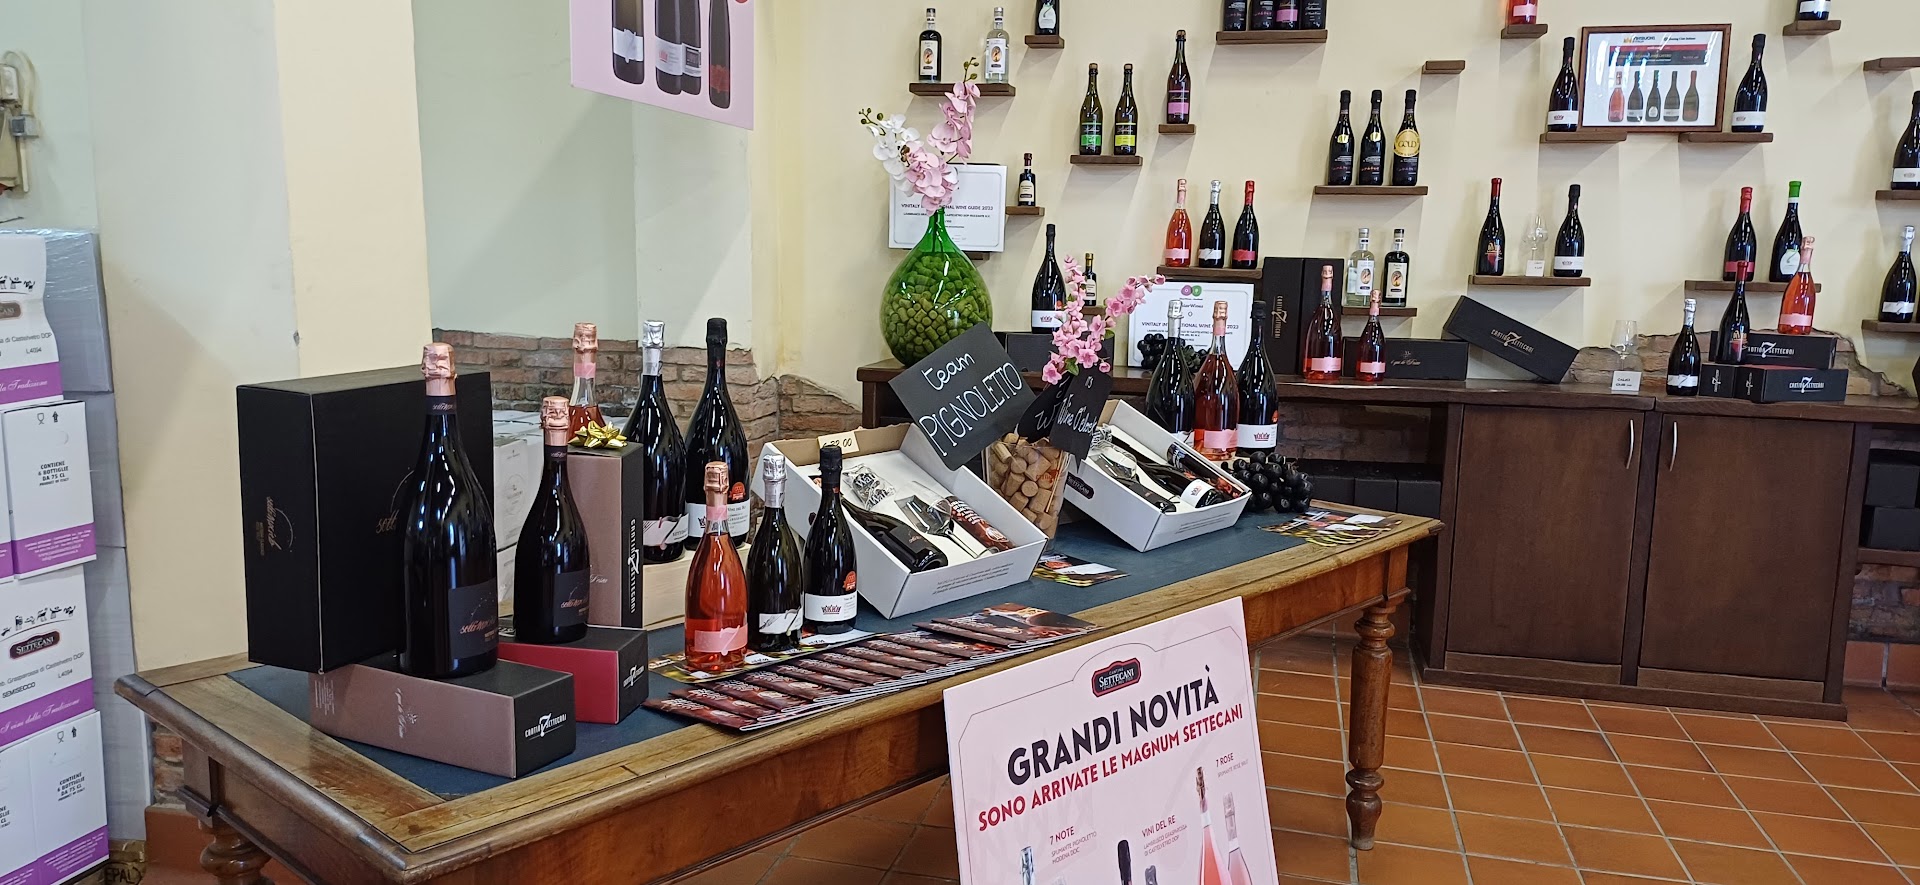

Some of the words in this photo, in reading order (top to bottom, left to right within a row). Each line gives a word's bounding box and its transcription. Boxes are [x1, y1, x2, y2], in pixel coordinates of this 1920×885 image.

[1397, 140, 1417, 148] GOLD
[922, 352, 976, 391] team
[918, 362, 1023, 457] PIGNOLETTO
[40, 460, 66, 470] CONTIENE
[43, 466, 69, 475] BOTTIGLIE
[16, 636, 55, 654] SETTECANI
[1098, 668, 1135, 688] SETTECANI
[2, 681, 36, 698] SEMISECCO
[1007, 711, 1122, 786] GRANDI
[1128, 664, 1220, 738] NOVITÀ
[978, 795, 1026, 832] SONO
[1031, 763, 1099, 810] ARRIVATE
[1102, 755, 1118, 778] LE
[1120, 729, 1180, 770] MAGNUM
[1182, 703, 1243, 743] SETTECANI
[59, 771, 82, 786] CONTIENE
[61, 776, 85, 791] BOTTIGLIE
[1141, 825, 1155, 838] VINI
[1155, 819, 1167, 832] DEL
[1167, 814, 1176, 826] RE
[1049, 835, 1054, 845] 7
[1055, 826, 1075, 843] NOTE
[1072, 831, 1098, 848] PIGNOLETTO
[1051, 849, 1071, 865] MODENA
[1070, 846, 1081, 857] DOC
